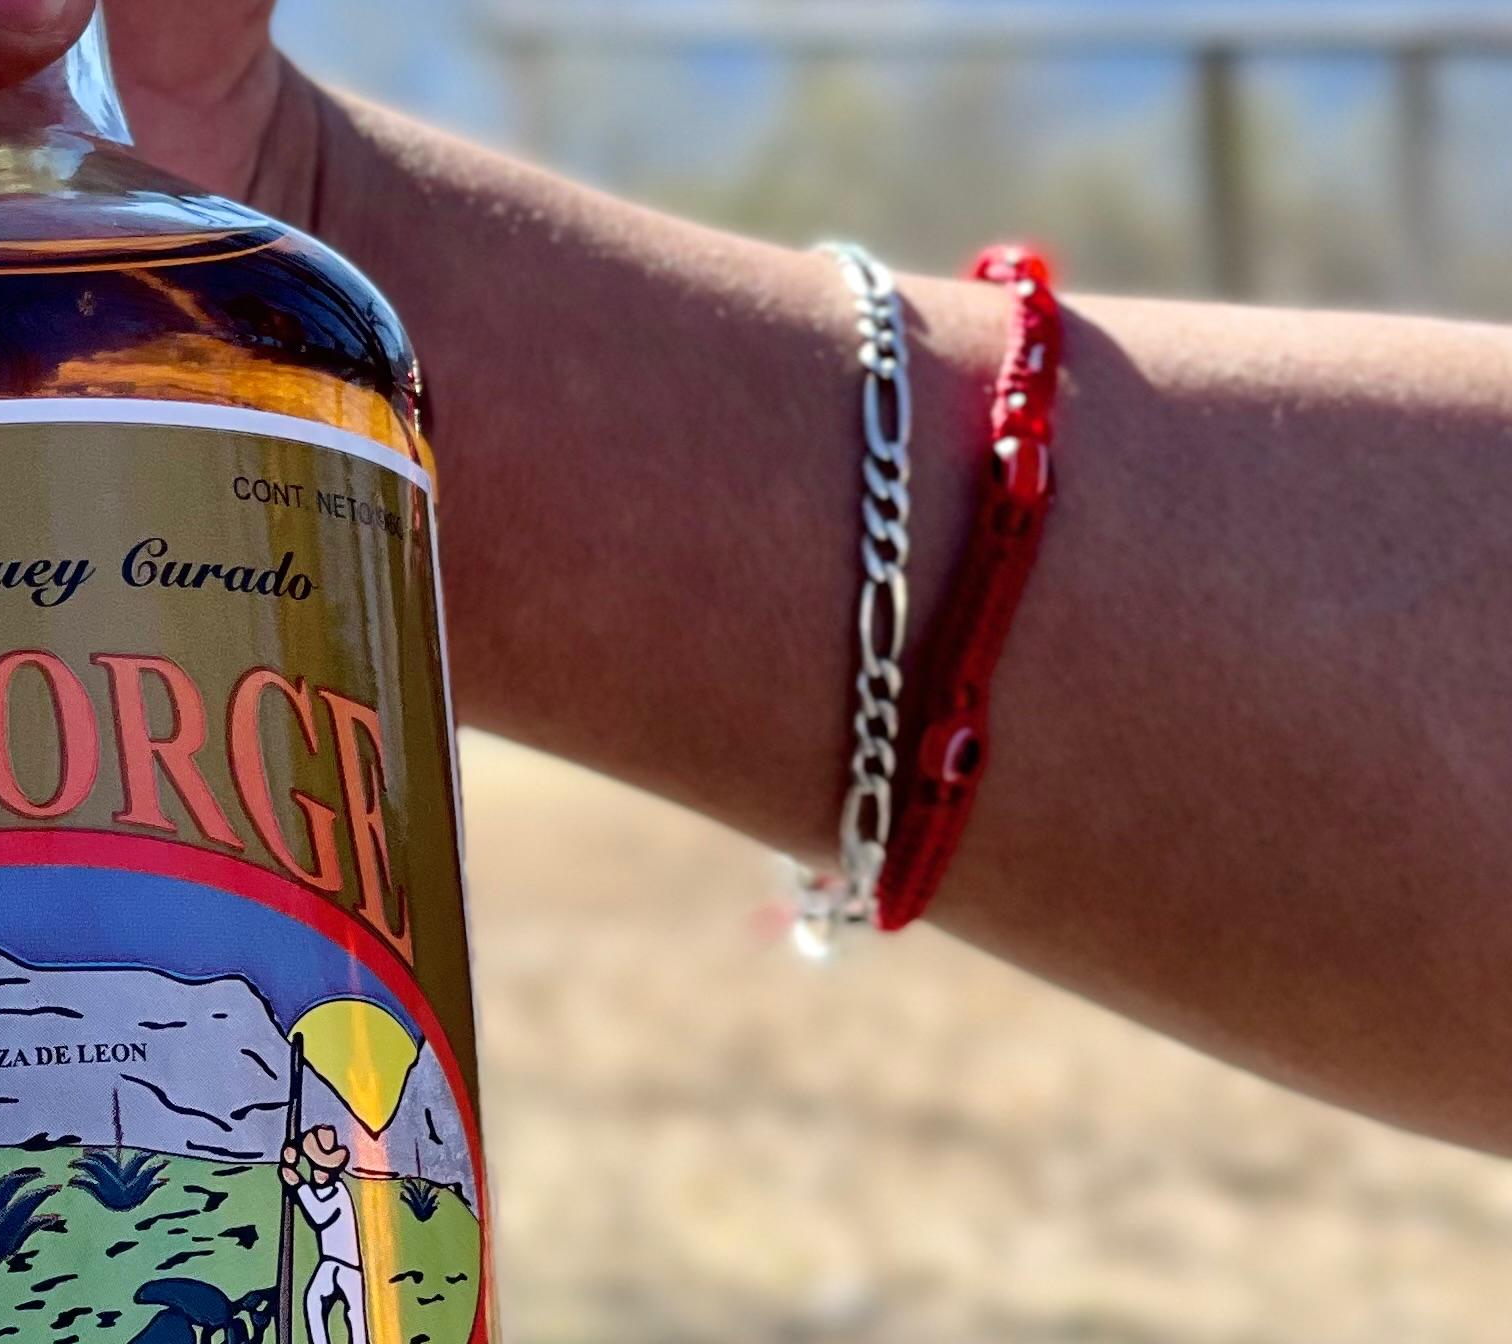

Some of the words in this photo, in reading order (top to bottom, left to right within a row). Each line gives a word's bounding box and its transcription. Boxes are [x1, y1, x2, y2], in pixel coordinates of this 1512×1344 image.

[233, 476, 304, 507] CONT
[122, 537, 318, 601] Curado
[35, 1045, 72, 1066] DE
[77, 1042, 148, 1064] LEON
